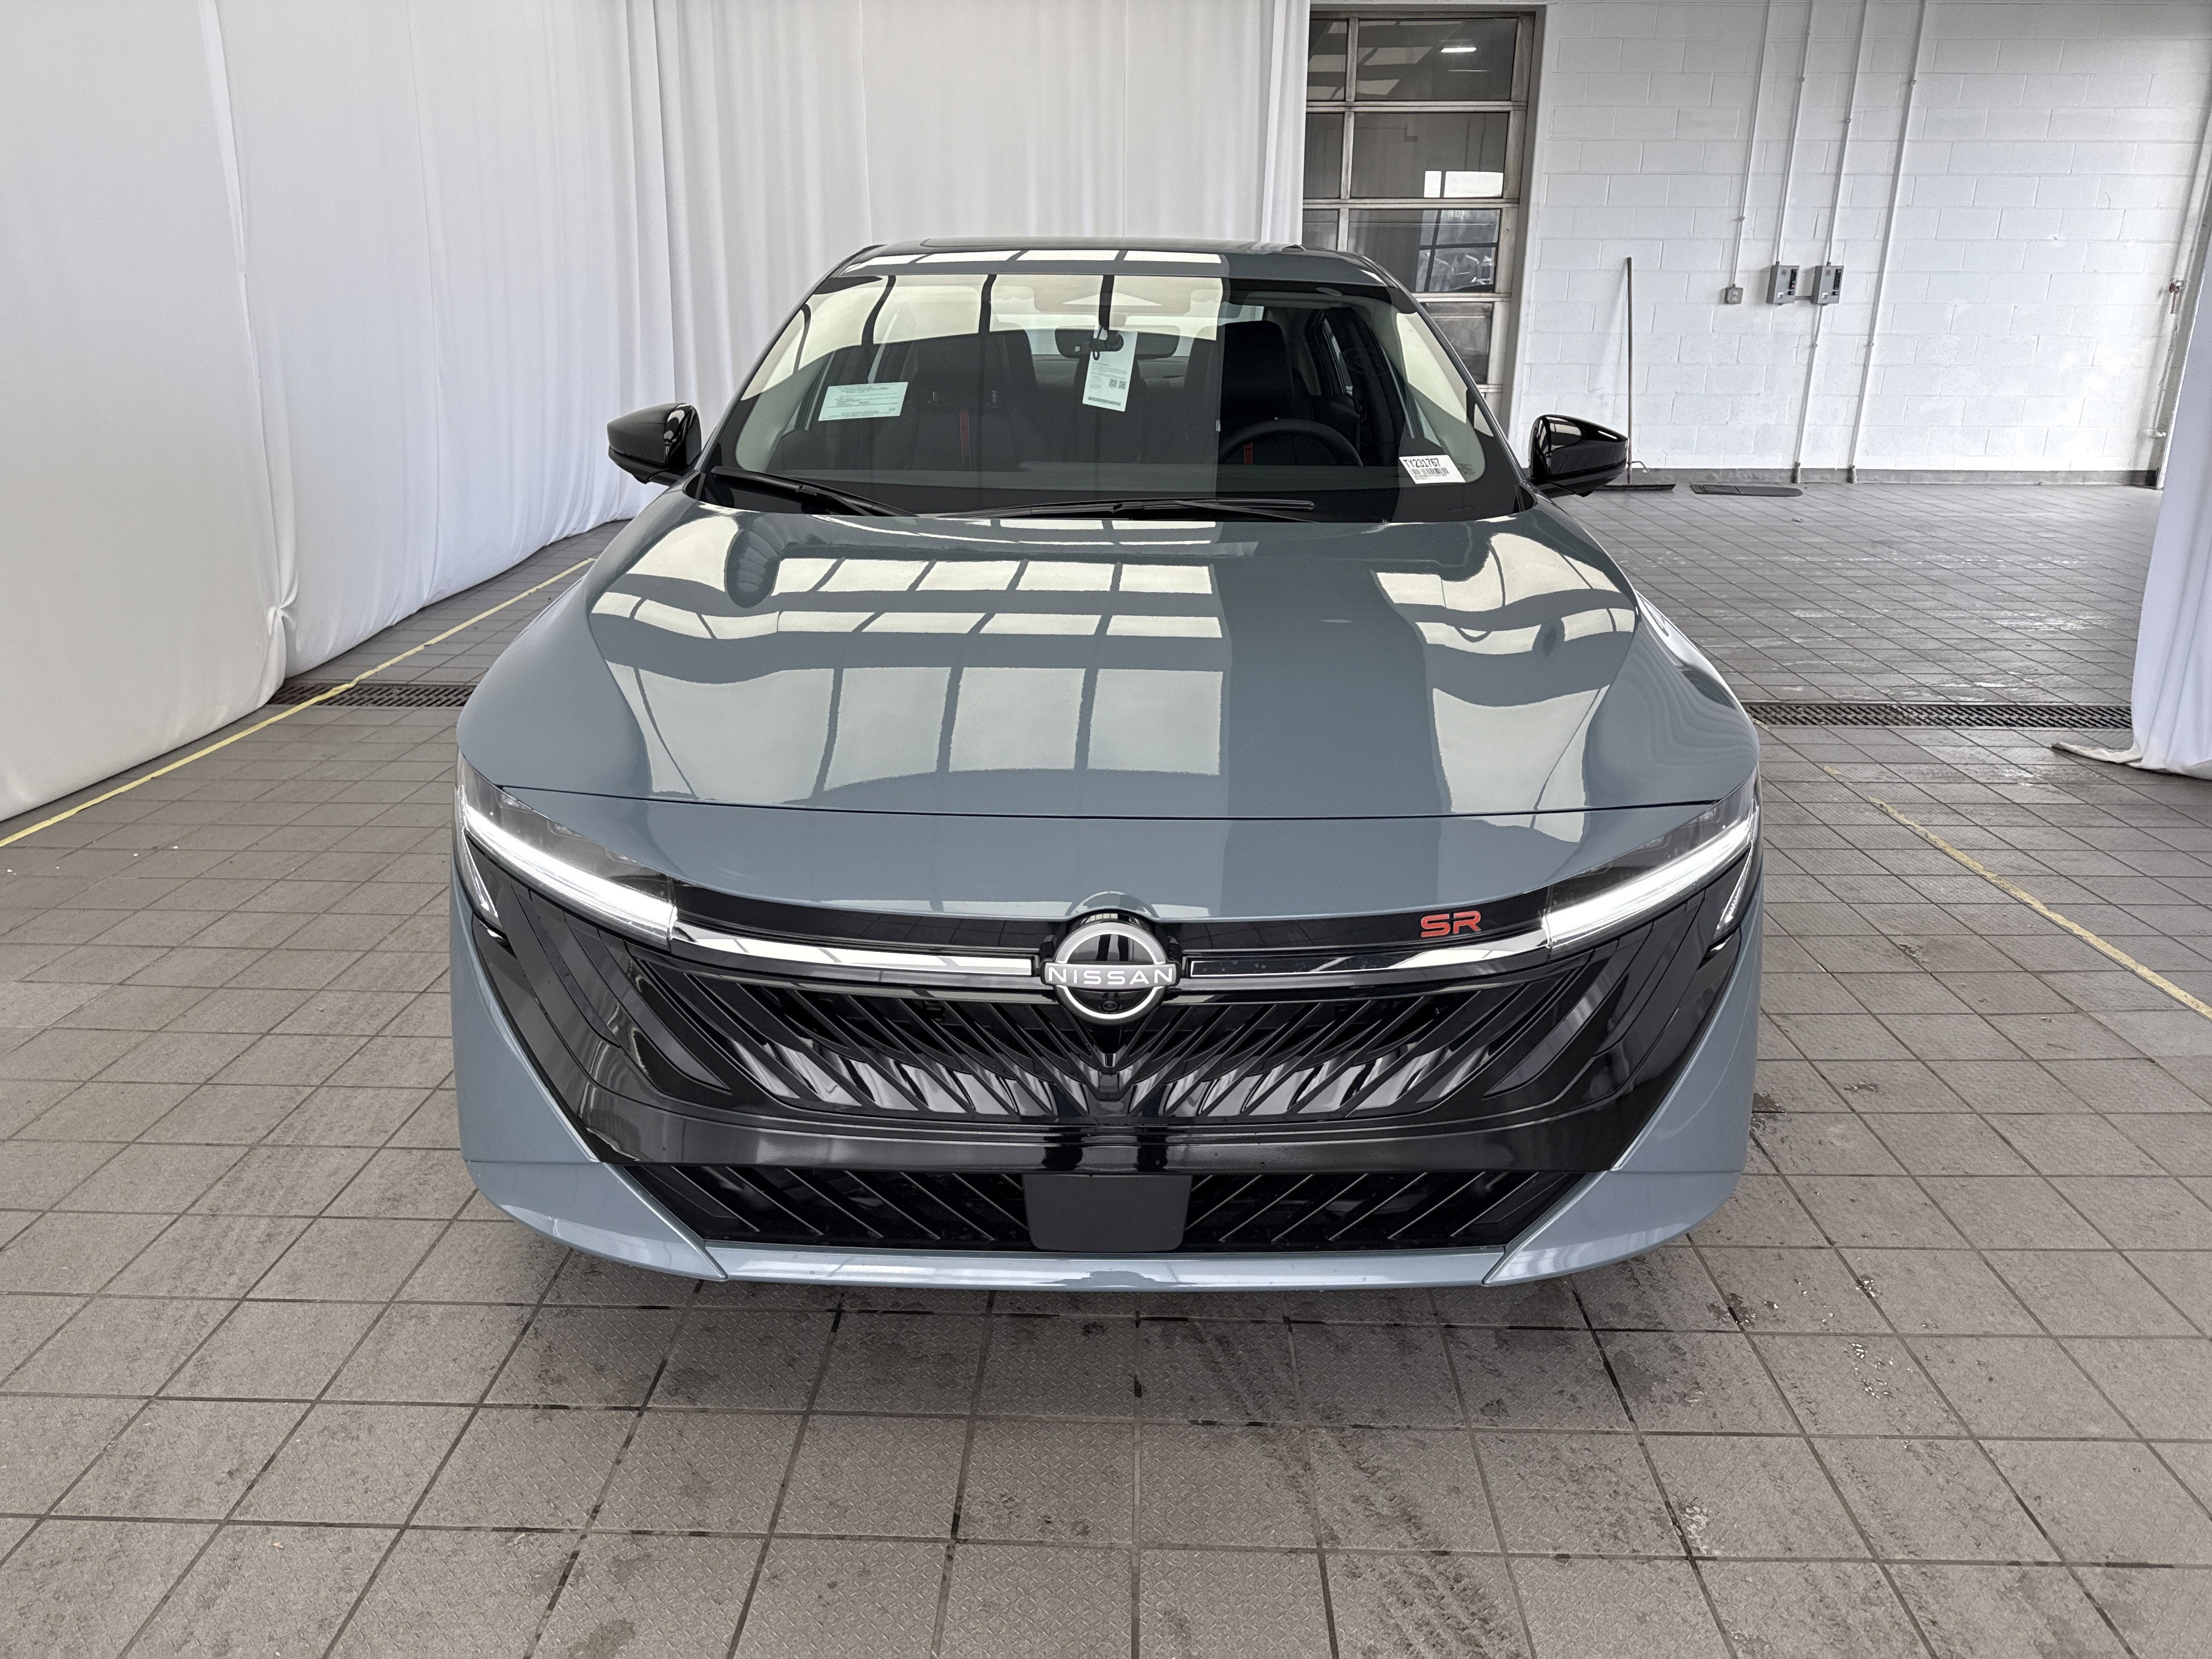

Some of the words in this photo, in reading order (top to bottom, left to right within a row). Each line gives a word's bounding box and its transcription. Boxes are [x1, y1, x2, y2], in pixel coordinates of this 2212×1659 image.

[1403, 458, 1441, 468] TY231767
[1421, 911, 1481, 937] SR
[1048, 967, 1172, 985] NISSAN
